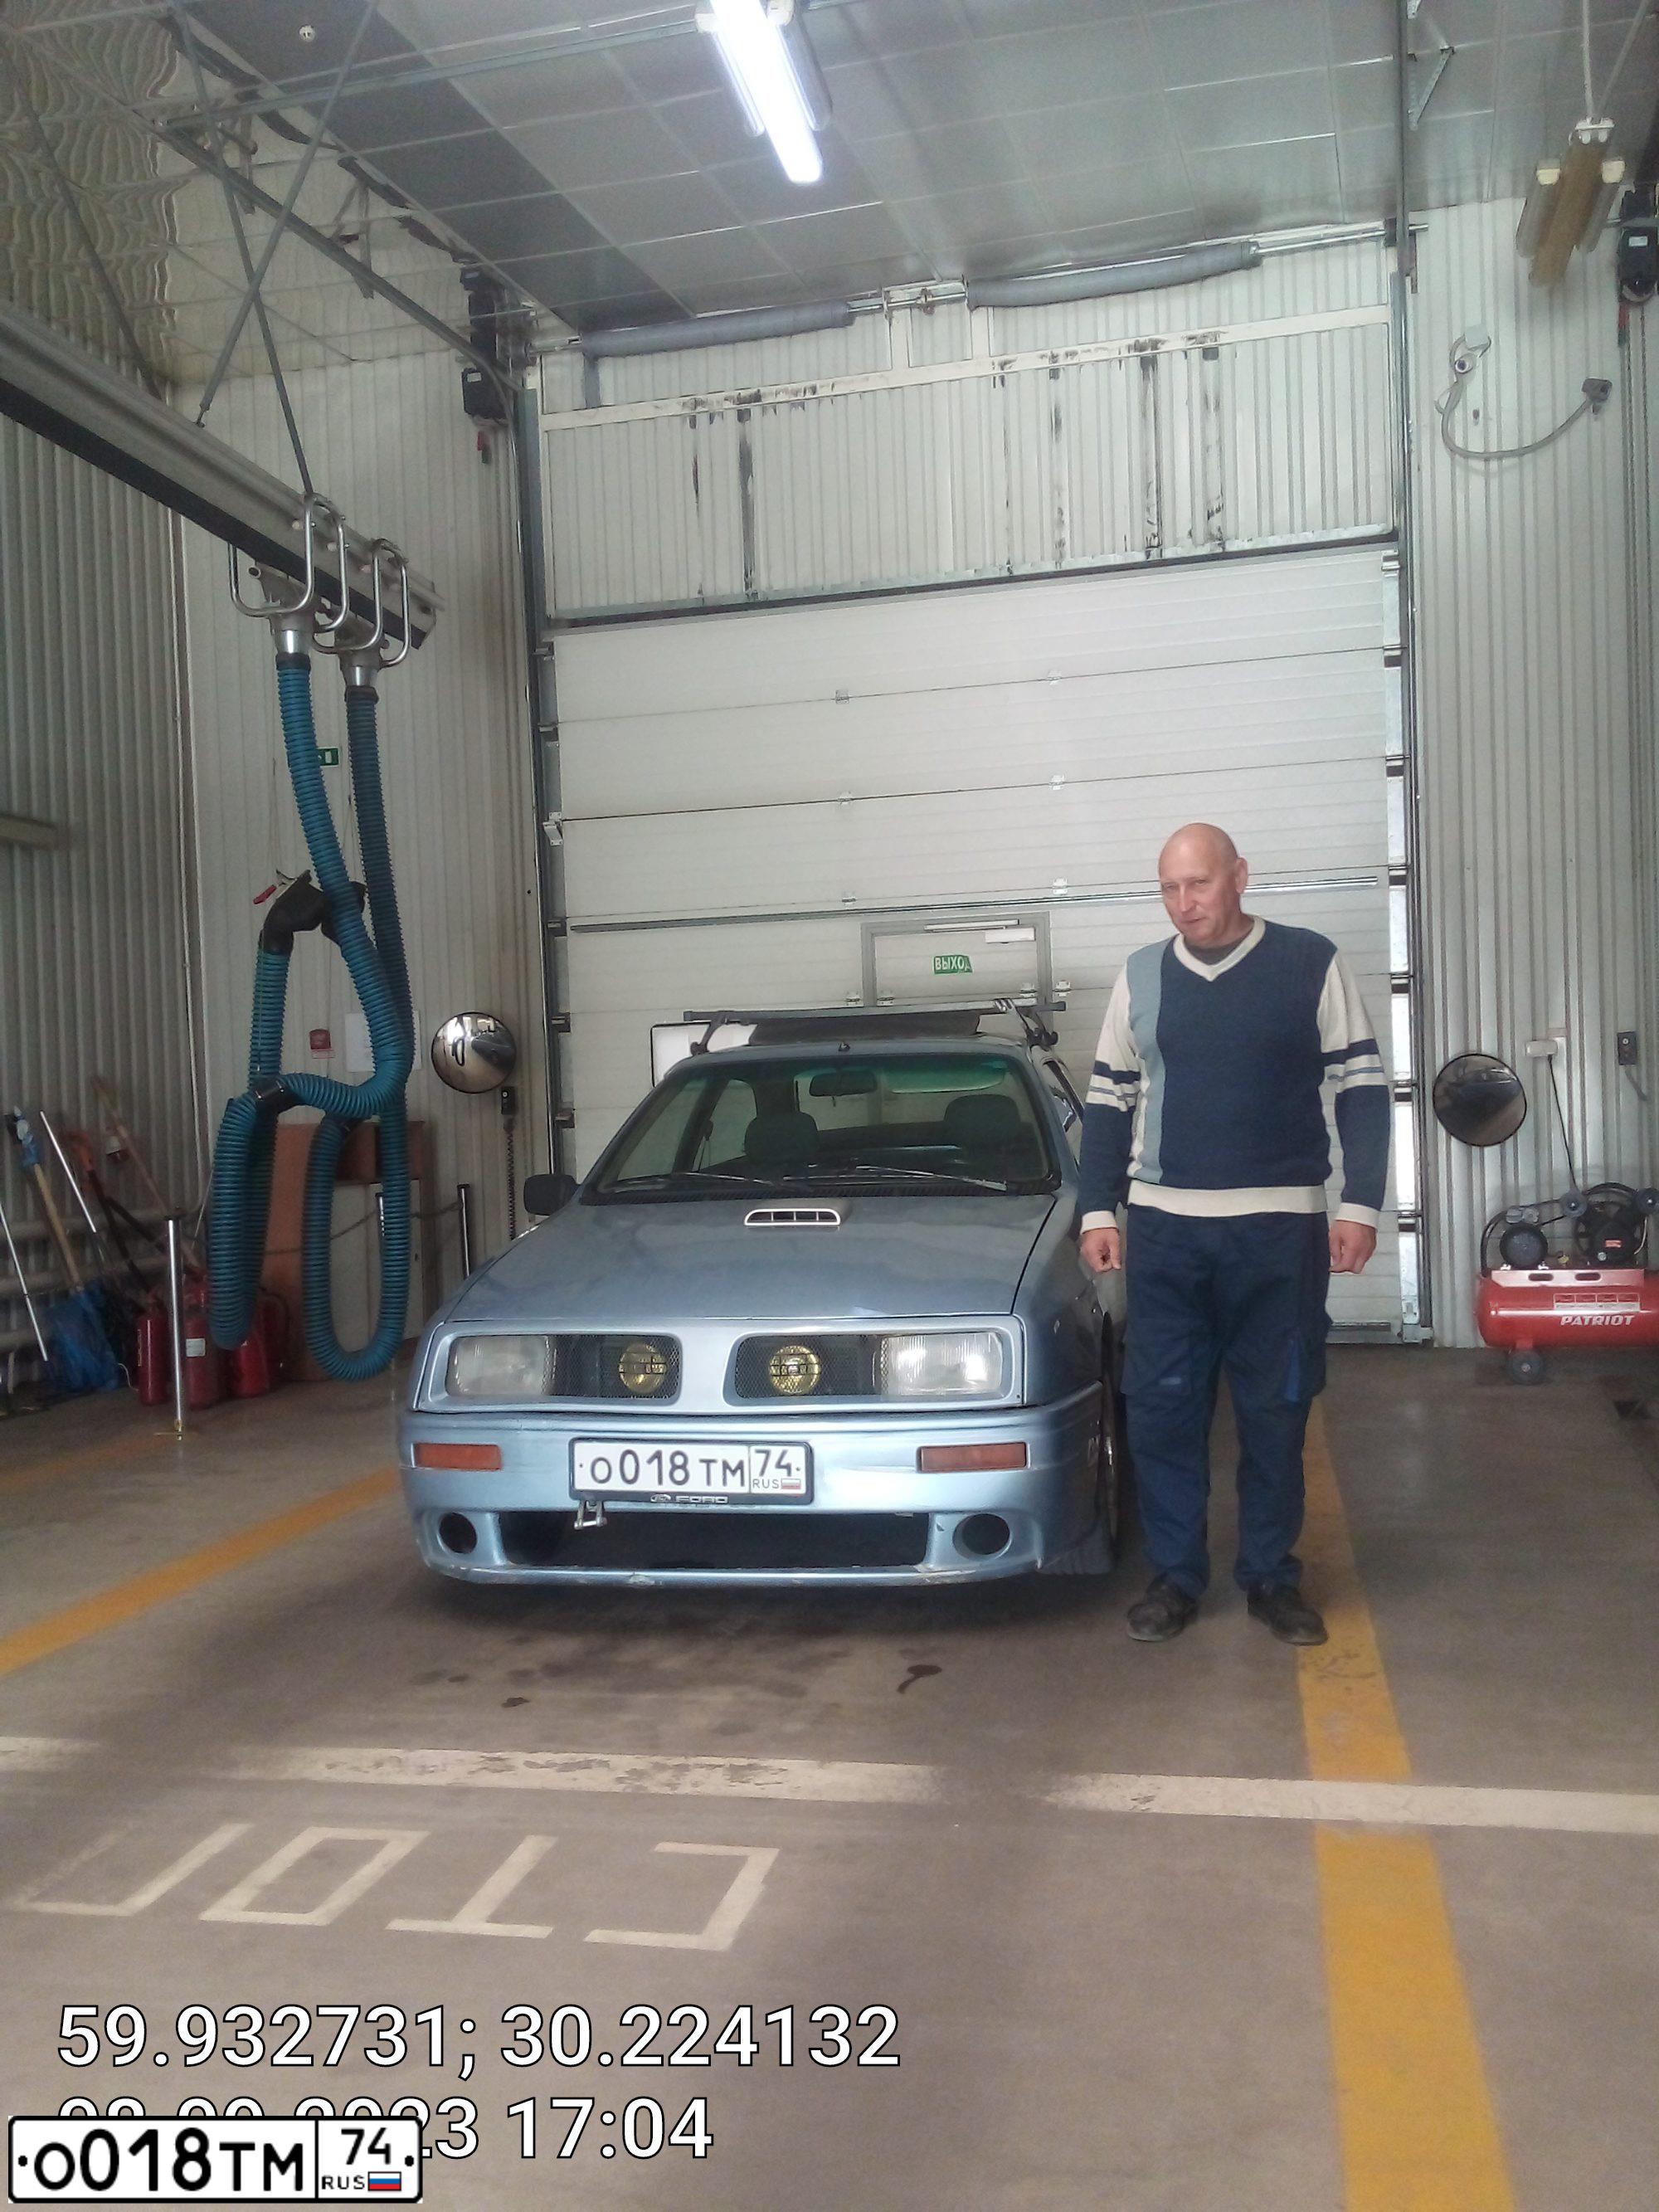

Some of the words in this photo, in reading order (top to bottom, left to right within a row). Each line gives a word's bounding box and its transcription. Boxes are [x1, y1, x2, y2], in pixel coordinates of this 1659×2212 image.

[1560, 1314, 1635, 1326] PATRIOT
[754, 1449, 793, 1477] 74
[752, 1479, 780, 1490] RUS
